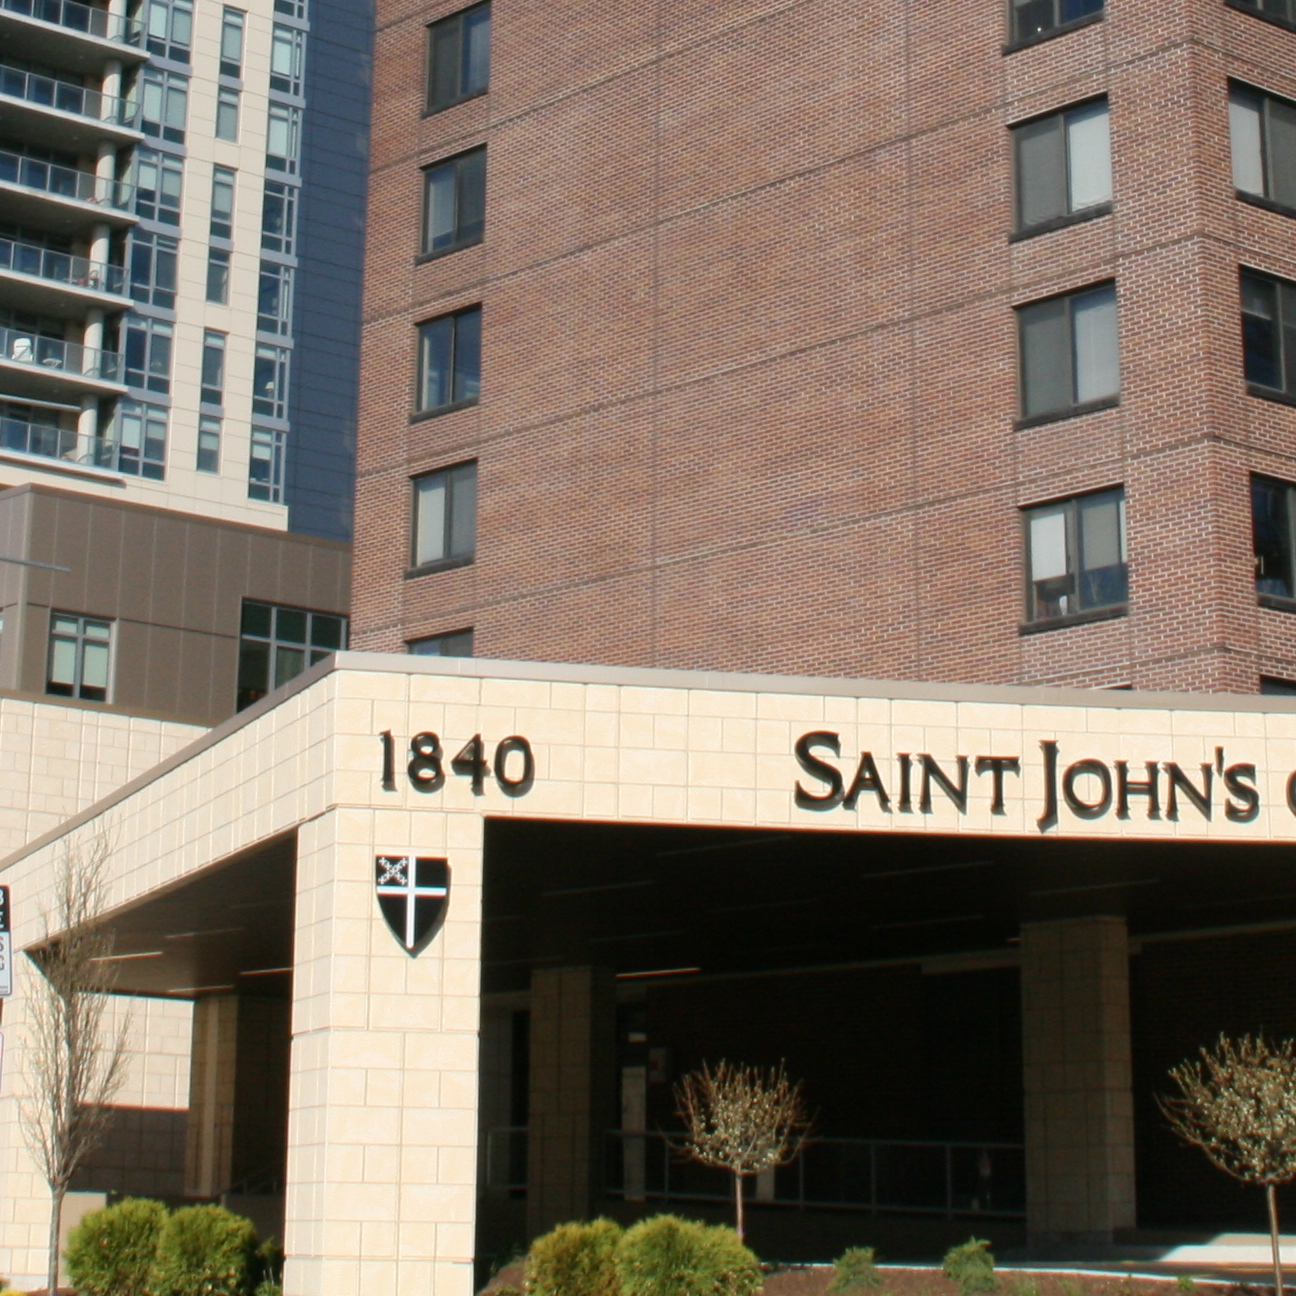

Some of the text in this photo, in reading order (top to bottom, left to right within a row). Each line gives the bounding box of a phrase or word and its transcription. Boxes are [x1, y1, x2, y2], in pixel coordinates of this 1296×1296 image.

[379, 729, 535, 798] 1840
[793, 730, 1021, 815] SAINT
[1036, 739, 1260, 833] JOHN'S
